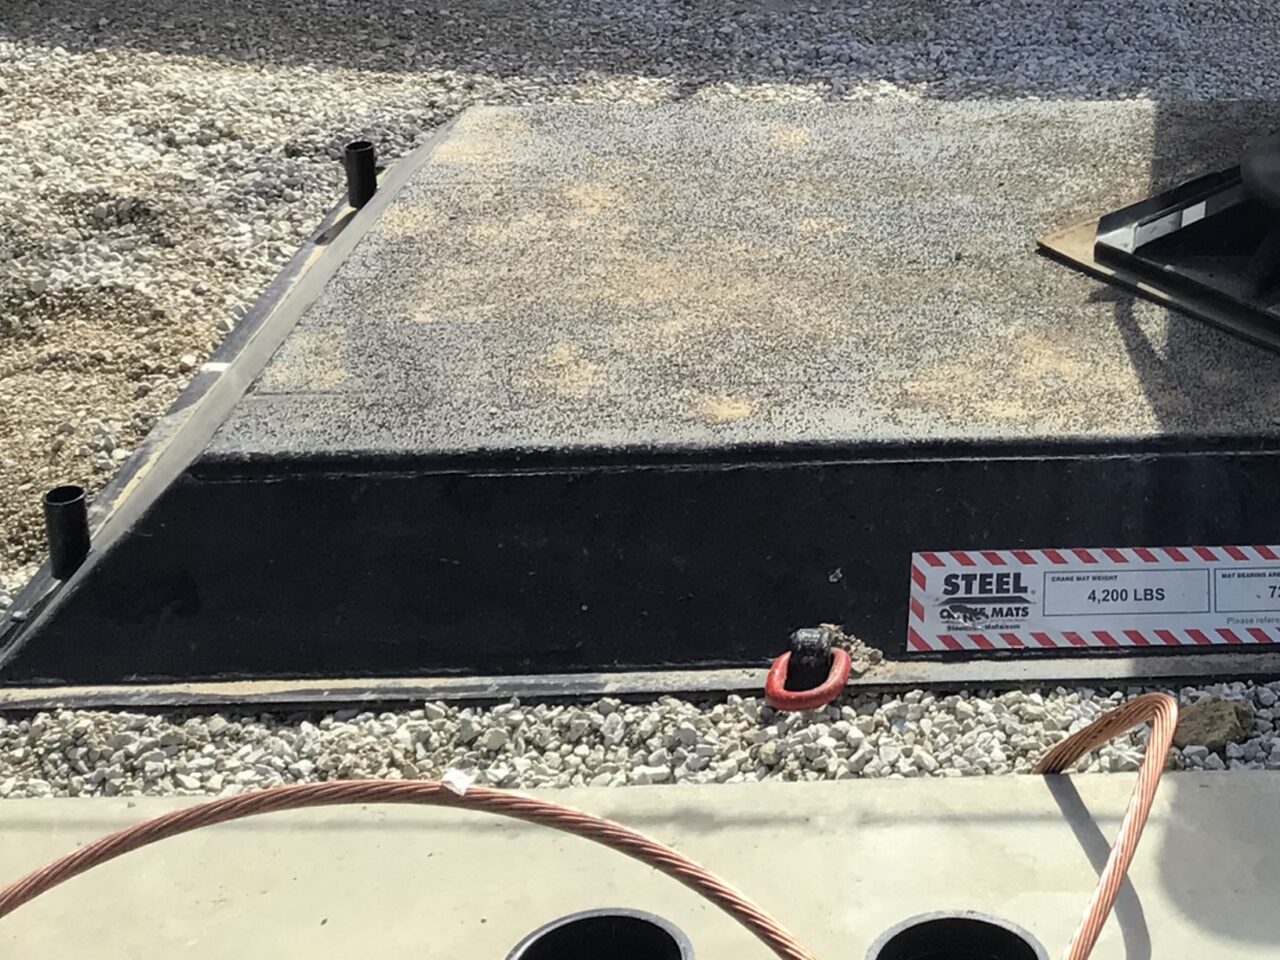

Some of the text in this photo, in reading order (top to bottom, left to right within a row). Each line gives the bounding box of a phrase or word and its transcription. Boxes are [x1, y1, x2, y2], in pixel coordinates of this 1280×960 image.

[942, 572, 1029, 596] STEEL
[1087, 588, 1166, 604] 4,200 LBS
[990, 606, 1030, 618] MATS
[1226, 617, 1254, 625] Please
